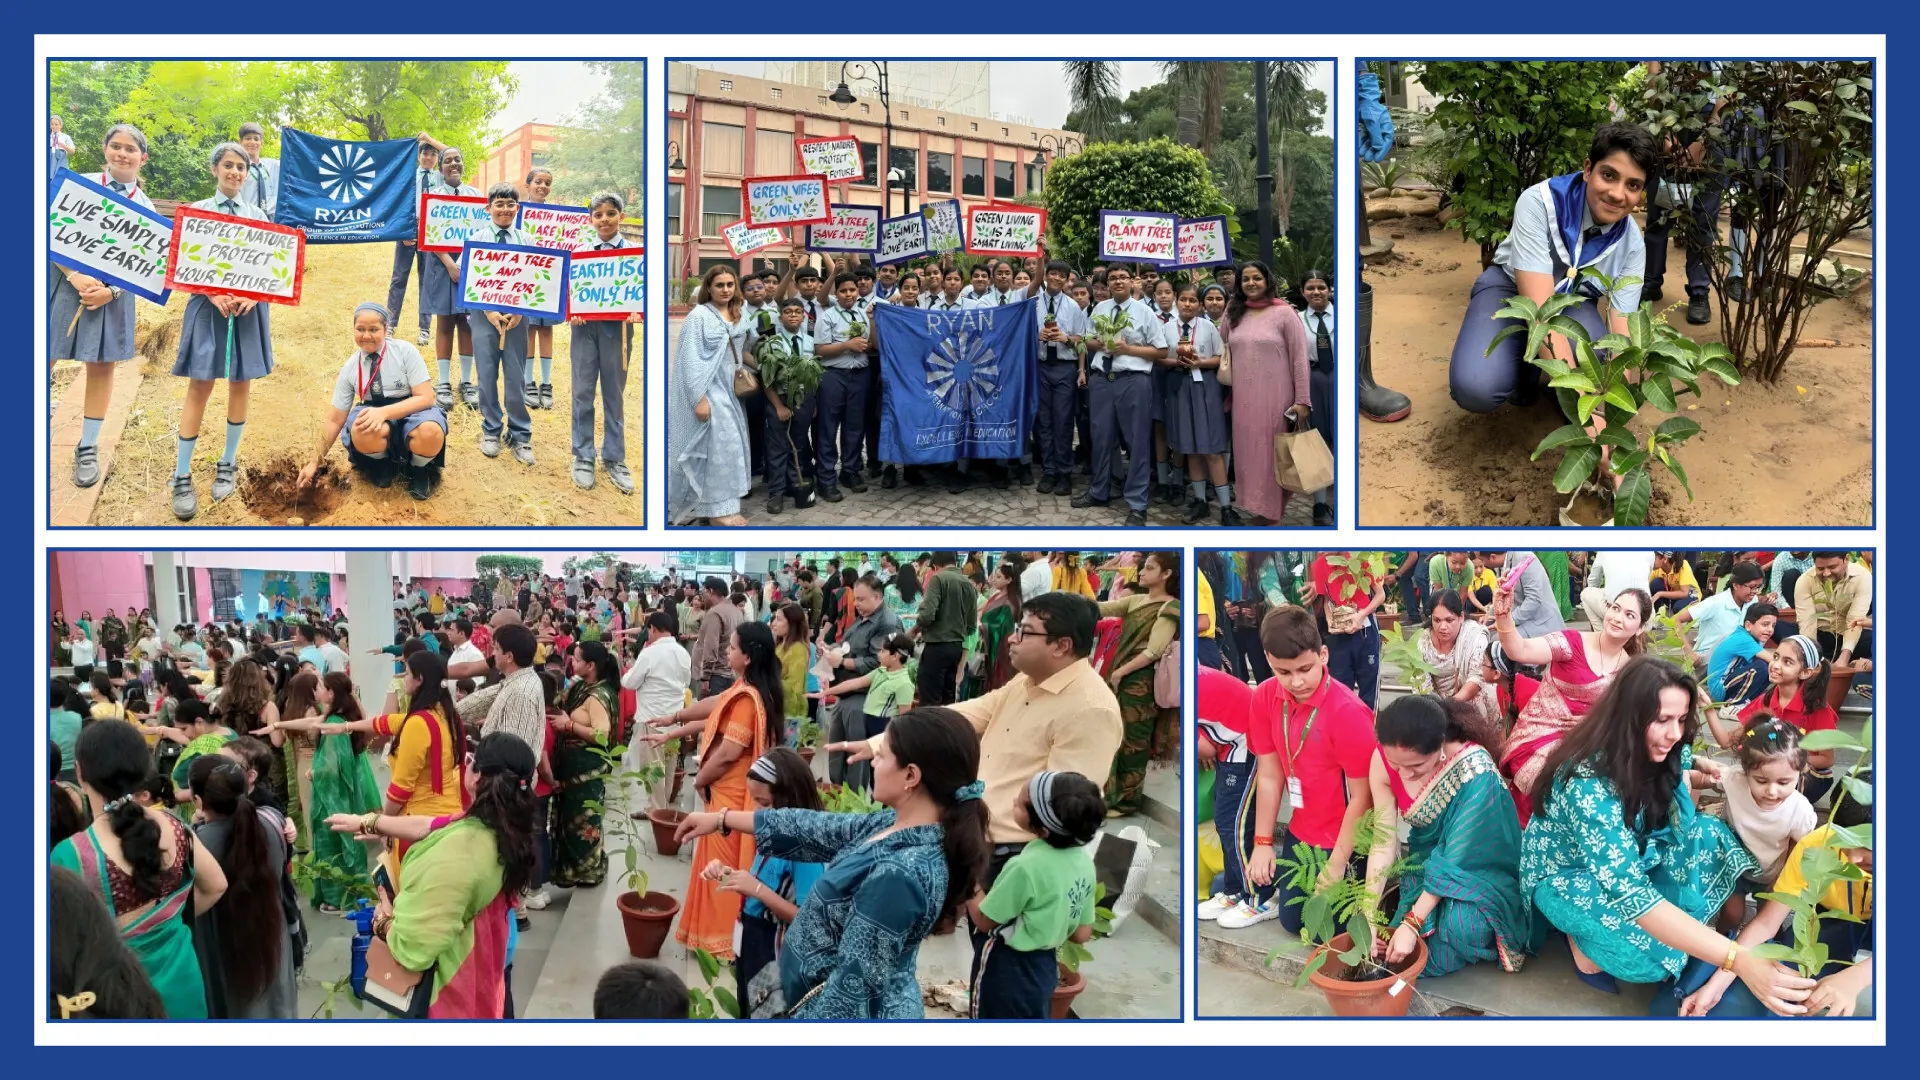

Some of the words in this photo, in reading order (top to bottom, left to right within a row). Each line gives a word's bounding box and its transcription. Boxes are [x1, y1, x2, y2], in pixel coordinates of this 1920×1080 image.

[803, 143, 830, 153] RESPECT
[832, 140, 855, 150] NATURE
[819, 154, 848, 164] PROTECT
[830, 168, 855, 178] FUTURE
[754, 185, 788, 198] GREEN
[58, 193, 104, 221] LIVE
[430, 204, 468, 219] GREEN
[770, 203, 802, 217] ONLY
[315, 207, 372, 222] RYAN
[524, 210, 554, 220] EARTH
[838, 217, 843, 226] A
[844, 217, 868, 226] TREE
[975, 213, 1003, 224] GREEN
[1006, 215, 1034, 225] LIVING
[185, 218, 244, 238] RESPECT
[245, 230, 297, 250] NATURE
[296, 224, 322, 233] GROUP
[444, 226, 479, 241] ONL
[536, 225, 557, 236] ARE
[562, 227, 580, 239] WE
[992, 227, 1003, 237] IS
[1005, 228, 1012, 237] A
[1109, 224, 1145, 237] PLANT
[1147, 226, 1172, 239] TREE
[1194, 222, 1216, 232] TREE
[814, 229, 839, 238] SAVE
[839, 230, 845, 238] A
[847, 230, 867, 240] LIFE
[882, 243, 901, 256] LOVE
[971, 238, 1000, 248] SMART
[1001, 240, 1027, 250] LIVING
[1107, 240, 1141, 252] PLANT
[1141, 243, 1168, 253] HOPE
[54, 225, 105, 254] LOVE
[101, 246, 156, 278] EARTH
[208, 244, 274, 266] PROTECT
[473, 250, 510, 262] PLANT
[508, 253, 520, 264] A
[524, 255, 556, 269] TREE
[496, 266, 522, 276] AND
[570, 262, 614, 280] EARTH
[619, 260, 635, 276] IS
[176, 266, 217, 284] YOUR
[221, 272, 280, 292] FUTURE
[475, 279, 508, 290] HOPE
[511, 282, 535, 294] FOR
[481, 292, 520, 306] FUTURE
[579, 286, 620, 302] ONLY
[926, 309, 994, 336] RYAN
[973, 426, 1016, 438] EDUCATION
